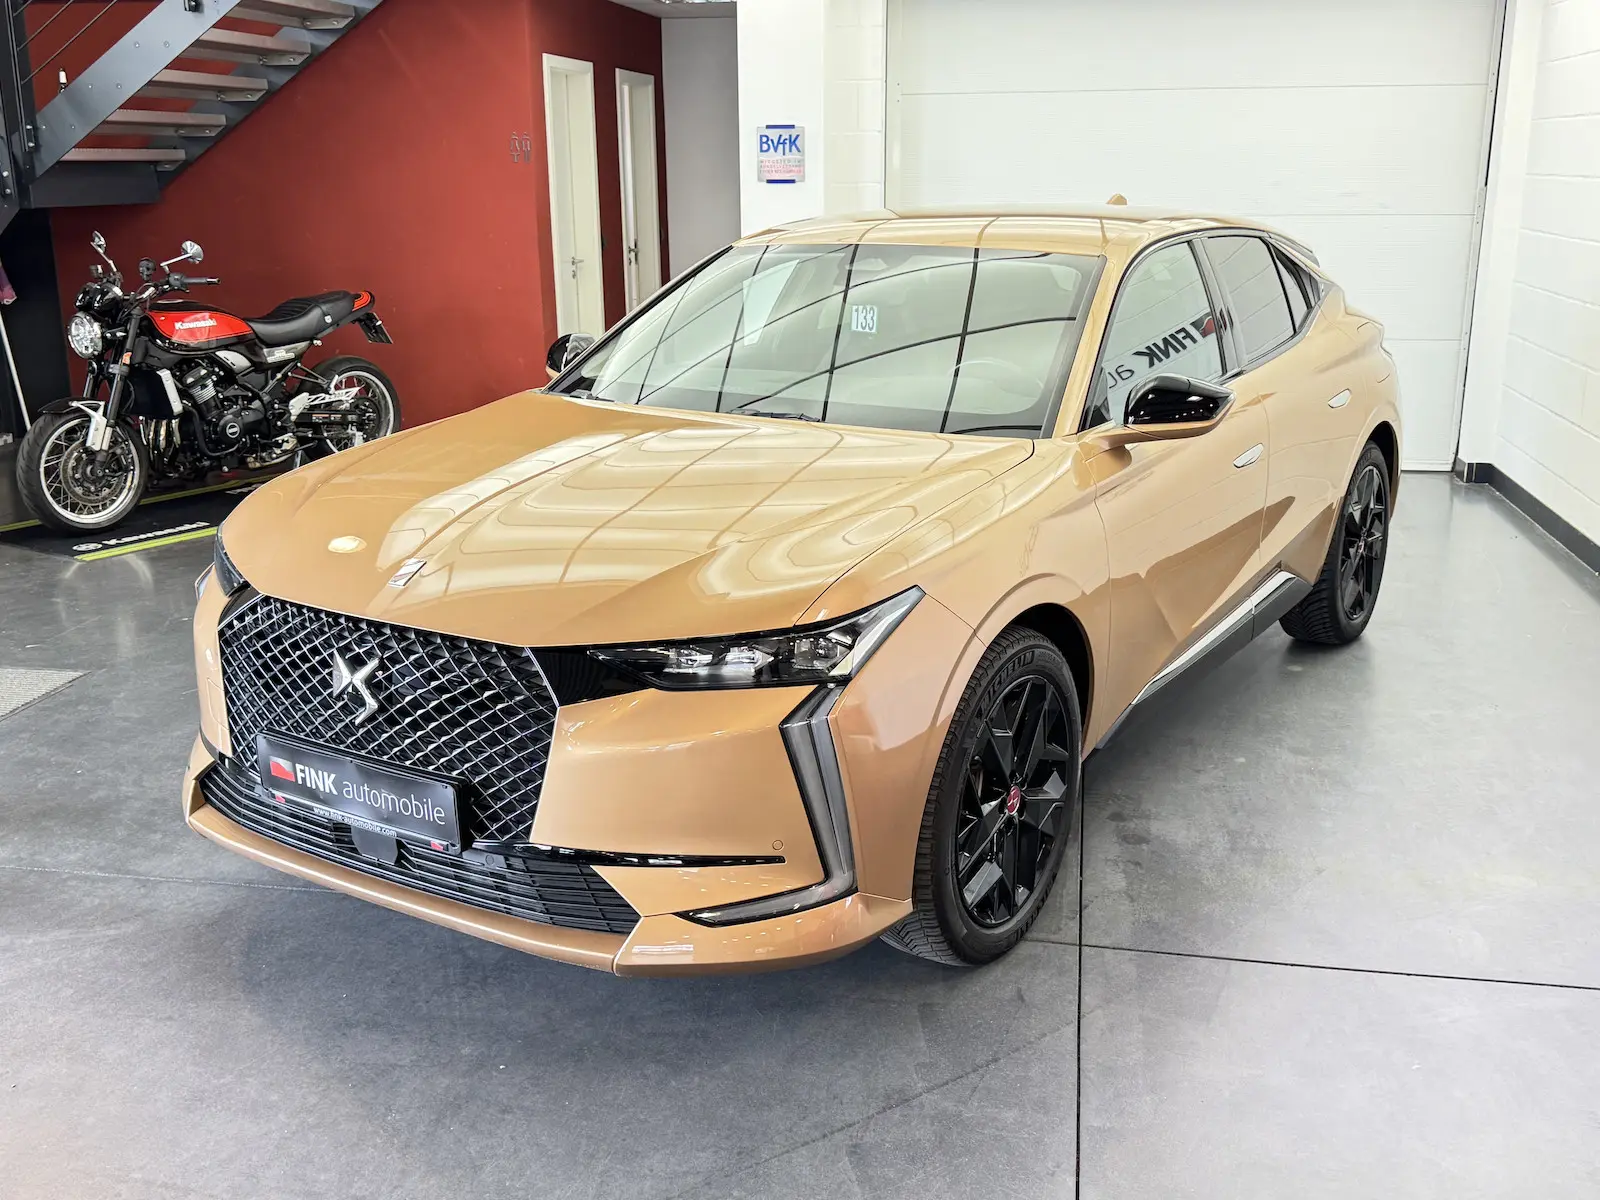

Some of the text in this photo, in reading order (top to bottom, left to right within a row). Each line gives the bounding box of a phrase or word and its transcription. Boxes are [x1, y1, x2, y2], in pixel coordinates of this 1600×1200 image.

[174, 318, 217, 330] Kawasaki
[854, 306, 875, 331] 133
[101, 521, 211, 545] Kawasaki
[976, 650, 1035, 719] MICHELIN
[295, 763, 446, 825] FINK automobile
[313, 806, 397, 837] www.fink-automobile.com
